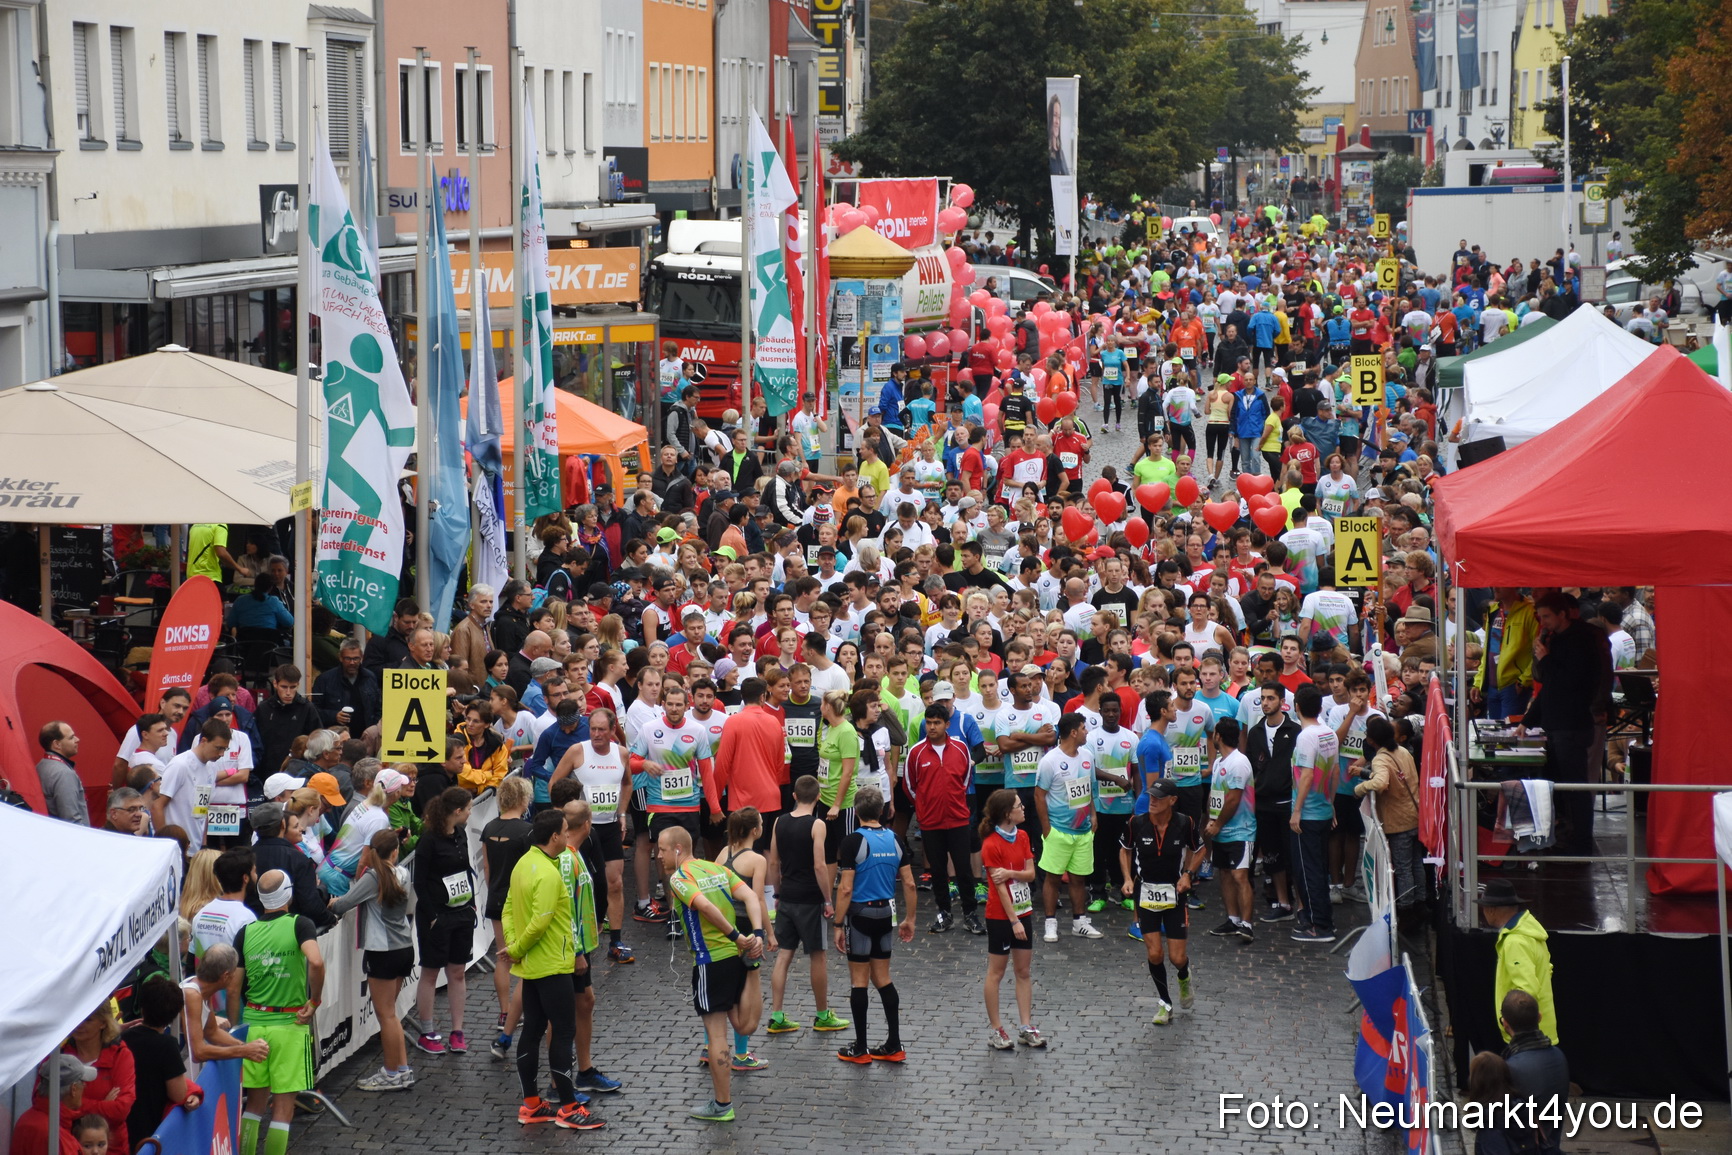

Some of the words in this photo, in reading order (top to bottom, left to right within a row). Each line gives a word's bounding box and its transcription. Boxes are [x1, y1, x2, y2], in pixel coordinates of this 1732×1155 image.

[1151, 223, 1158, 234] D
[1378, 220, 1386, 232] D
[917, 256, 945, 285] AVIA
[1383, 267, 1394, 283] C
[334, 270, 370, 297] Gebäude
[331, 291, 358, 307] UNS
[916, 289, 945, 313] Pellets
[681, 346, 715, 361] AVIA
[1355, 357, 1381, 367] Block
[1360, 371, 1377, 394] B
[0, 478, 59, 491] kter
[1324, 503, 1342, 512] 2318
[1341, 520, 1377, 532] Block
[1345, 537, 1373, 571] A
[165, 625, 199, 644] DKMS
[162, 672, 192, 684] dkms.de
[391, 674, 440, 690] Block
[396, 698, 432, 742] A
[787, 725, 813, 736] 5156
[1014, 751, 1039, 763] 5207
[1176, 754, 1198, 765] 5219
[664, 775, 690, 788] 5317
[1070, 783, 1090, 798] 5314
[592, 791, 617, 804] 5015
[208, 812, 237, 824] 2800
[1147, 889, 1167, 901] 301
[128, 885, 165, 951] Neumarkt
